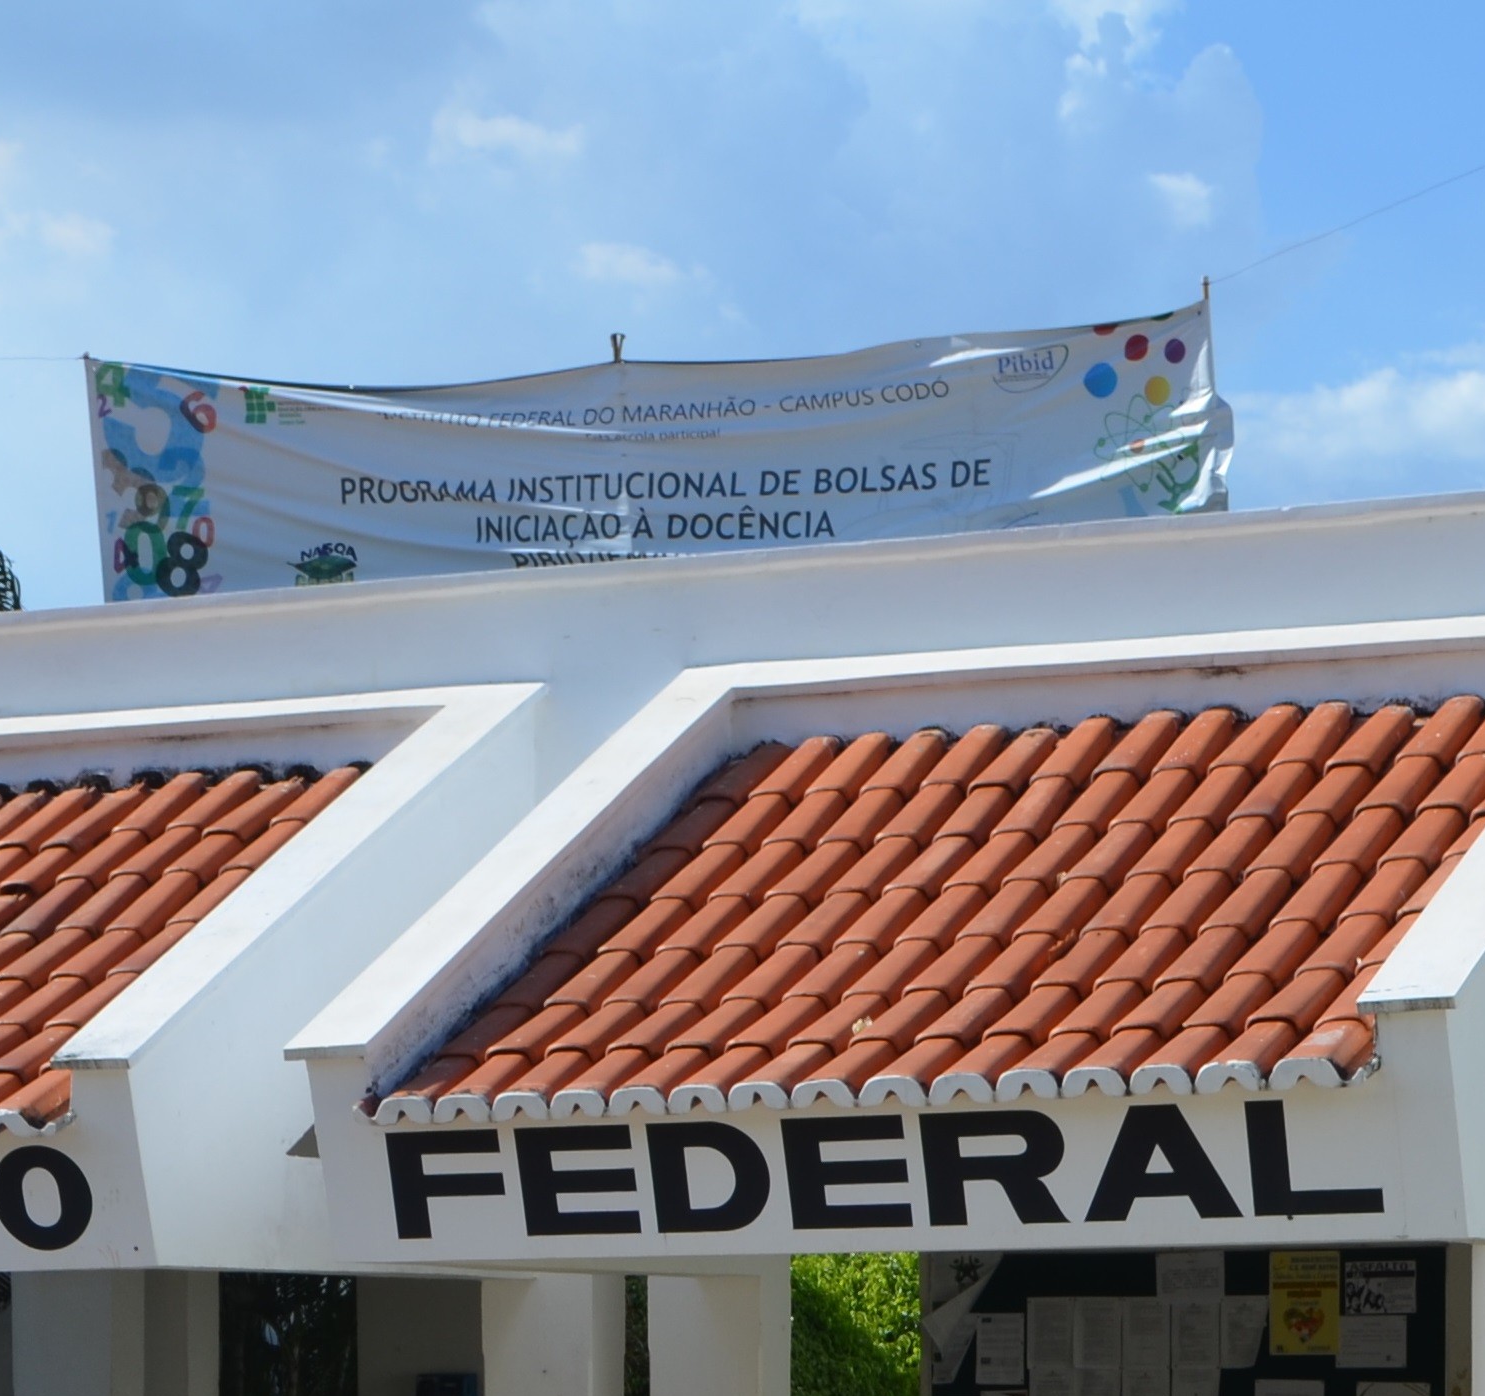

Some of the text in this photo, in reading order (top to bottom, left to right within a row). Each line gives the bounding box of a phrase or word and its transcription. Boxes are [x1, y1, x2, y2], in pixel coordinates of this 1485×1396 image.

[998, 350, 1054, 374] Pibid
[180, 391, 217, 433] 6
[489, 410, 576, 428] FEDERAL
[583, 407, 615, 426] DO
[622, 396, 756, 423] MARANHÃO
[779, 389, 874, 414] CAMPUS
[881, 375, 950, 403] CODÓ
[340, 459, 992, 504] PROGRAMA INSTITUCIONAL DE BOLSAS DE
[632, 507, 655, 539] À
[667, 505, 836, 541] DOCÊNCIA
[156, 531, 209, 597] 8
[384, 1099, 1386, 1241] FEDERAL
